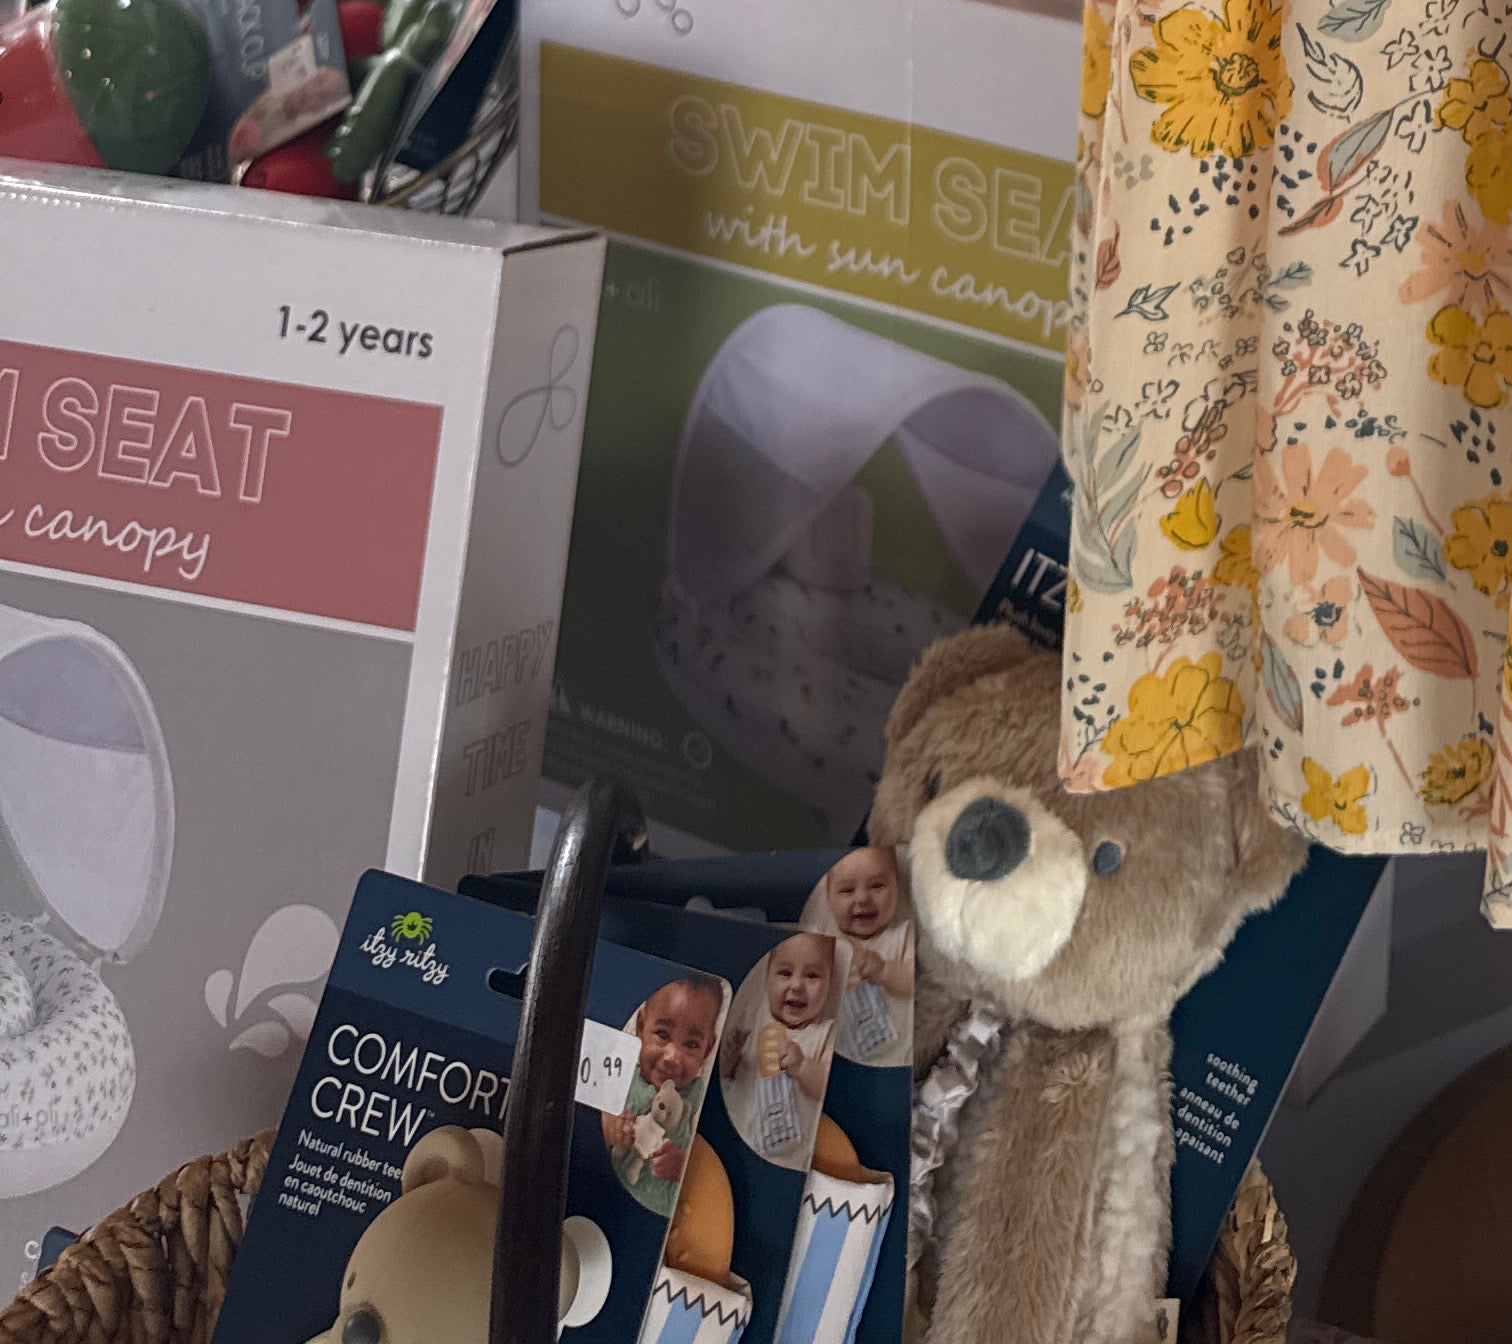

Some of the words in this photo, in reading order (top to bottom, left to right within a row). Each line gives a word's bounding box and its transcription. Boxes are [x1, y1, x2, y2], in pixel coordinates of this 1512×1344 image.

[670, 94, 912, 227] SWIM
[706, 205, 817, 259] with
[827, 239, 921, 284] sun
[277, 305, 329, 343] 1-2
[339, 319, 434, 359] years
[37, 375, 293, 504] SEAT
[24, 503, 211, 581] canopy
[456, 619, 555, 708] HAPPY
[463, 716, 533, 797] TIME
[359, 926, 400, 969] itzy
[399, 943, 450, 986] ritzy
[328, 1023, 514, 1122] COMFORT
[580, 1056, 623, 1087] 0.99
[1205, 1071, 1252, 1106] teether
[1206, 1052, 1259, 1095] soothing
[1176, 1104, 1232, 1147] dentition
[1180, 1087, 1223, 1120] anneau
[1223, 1111, 1240, 1130] de
[297, 1128, 344, 1159] Natural
[342, 1148, 382, 1173] rubber
[1175, 1127, 1225, 1165] apaisant
[283, 1174, 300, 1191] en
[300, 1178, 368, 1214] caoutchouc
[288, 1153, 322, 1175] Jouet
[323, 1165, 339, 1184] de
[338, 1170, 393, 1204] dentition
[277, 1192, 322, 1217] naturel
